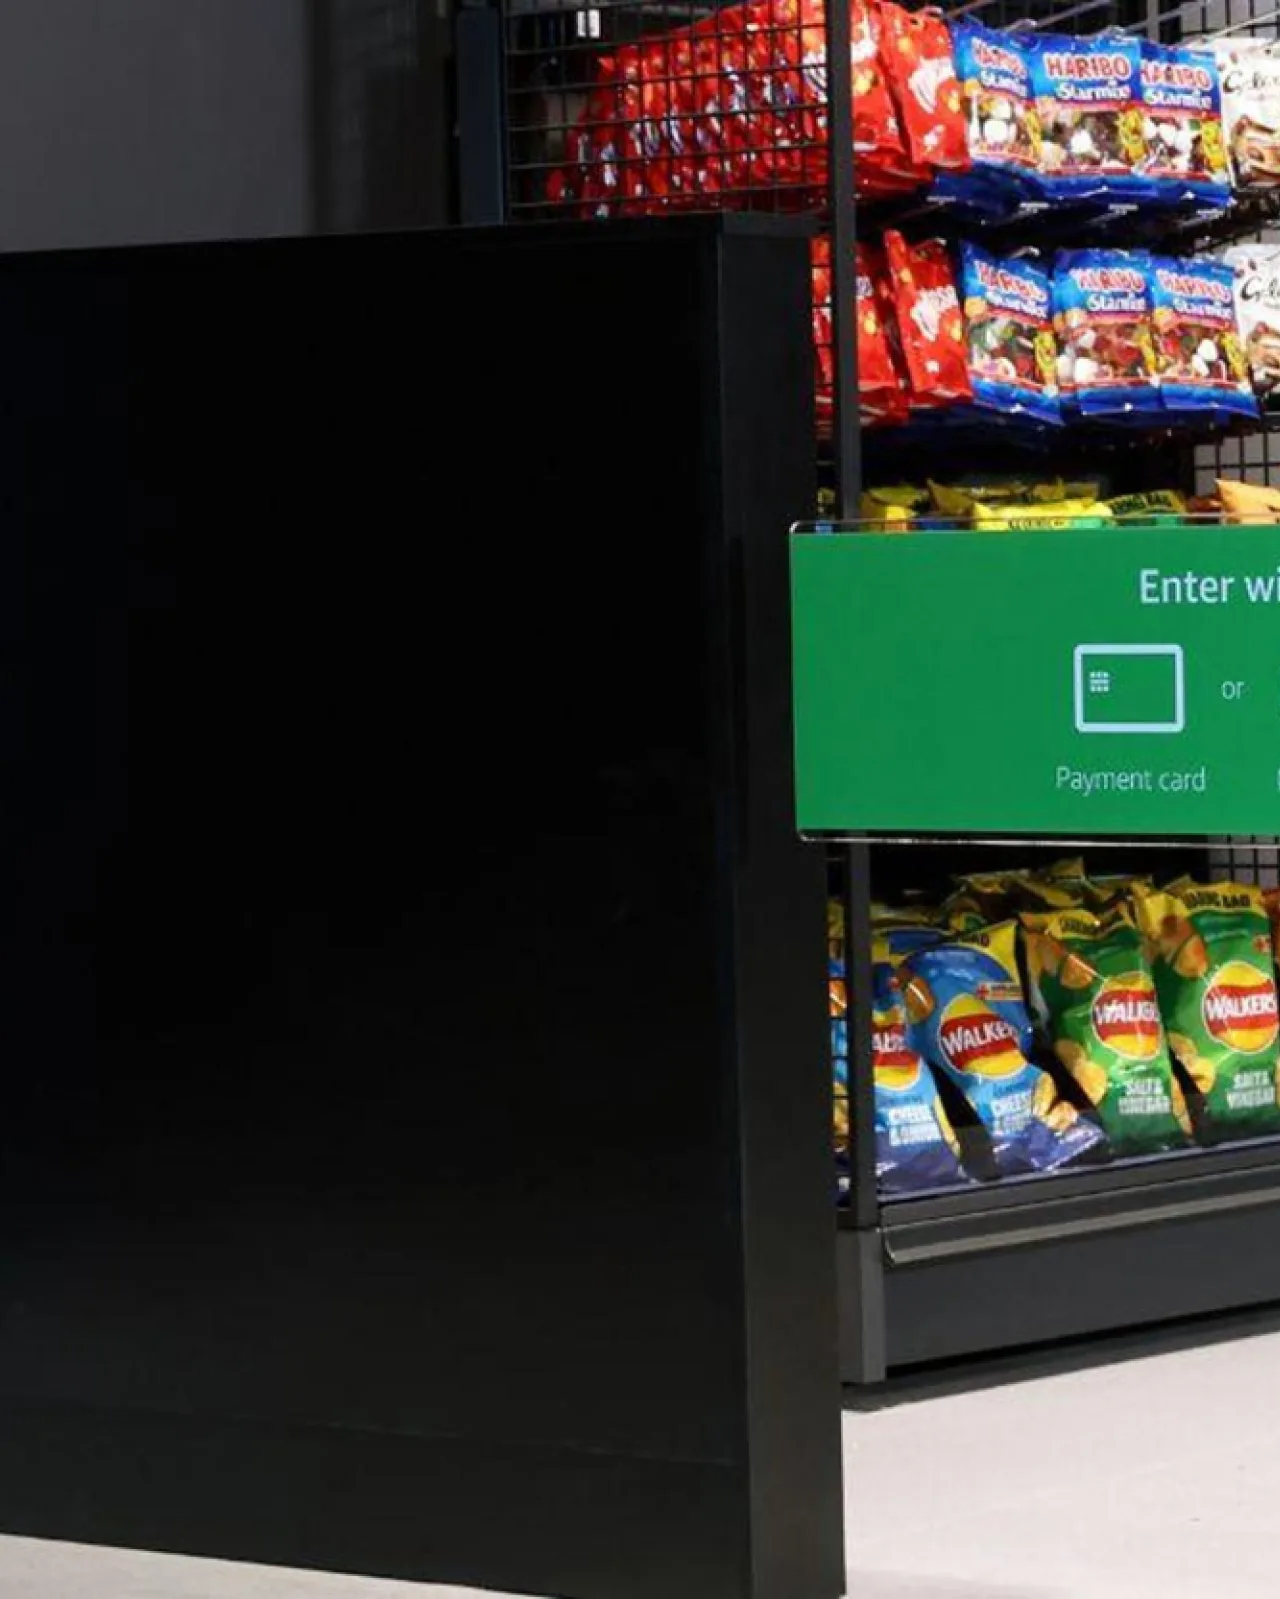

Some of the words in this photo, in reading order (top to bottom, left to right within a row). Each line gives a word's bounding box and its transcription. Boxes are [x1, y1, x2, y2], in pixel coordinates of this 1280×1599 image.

[1043, 53, 1132, 80] HARIBO
[1055, 80, 1132, 101] Starmix
[1140, 568, 1236, 604] Enter
[1221, 680, 1246, 700] or
[1055, 766, 1153, 797] Payment
[1158, 766, 1207, 792] card
[1206, 992, 1278, 1021] WALKERS
